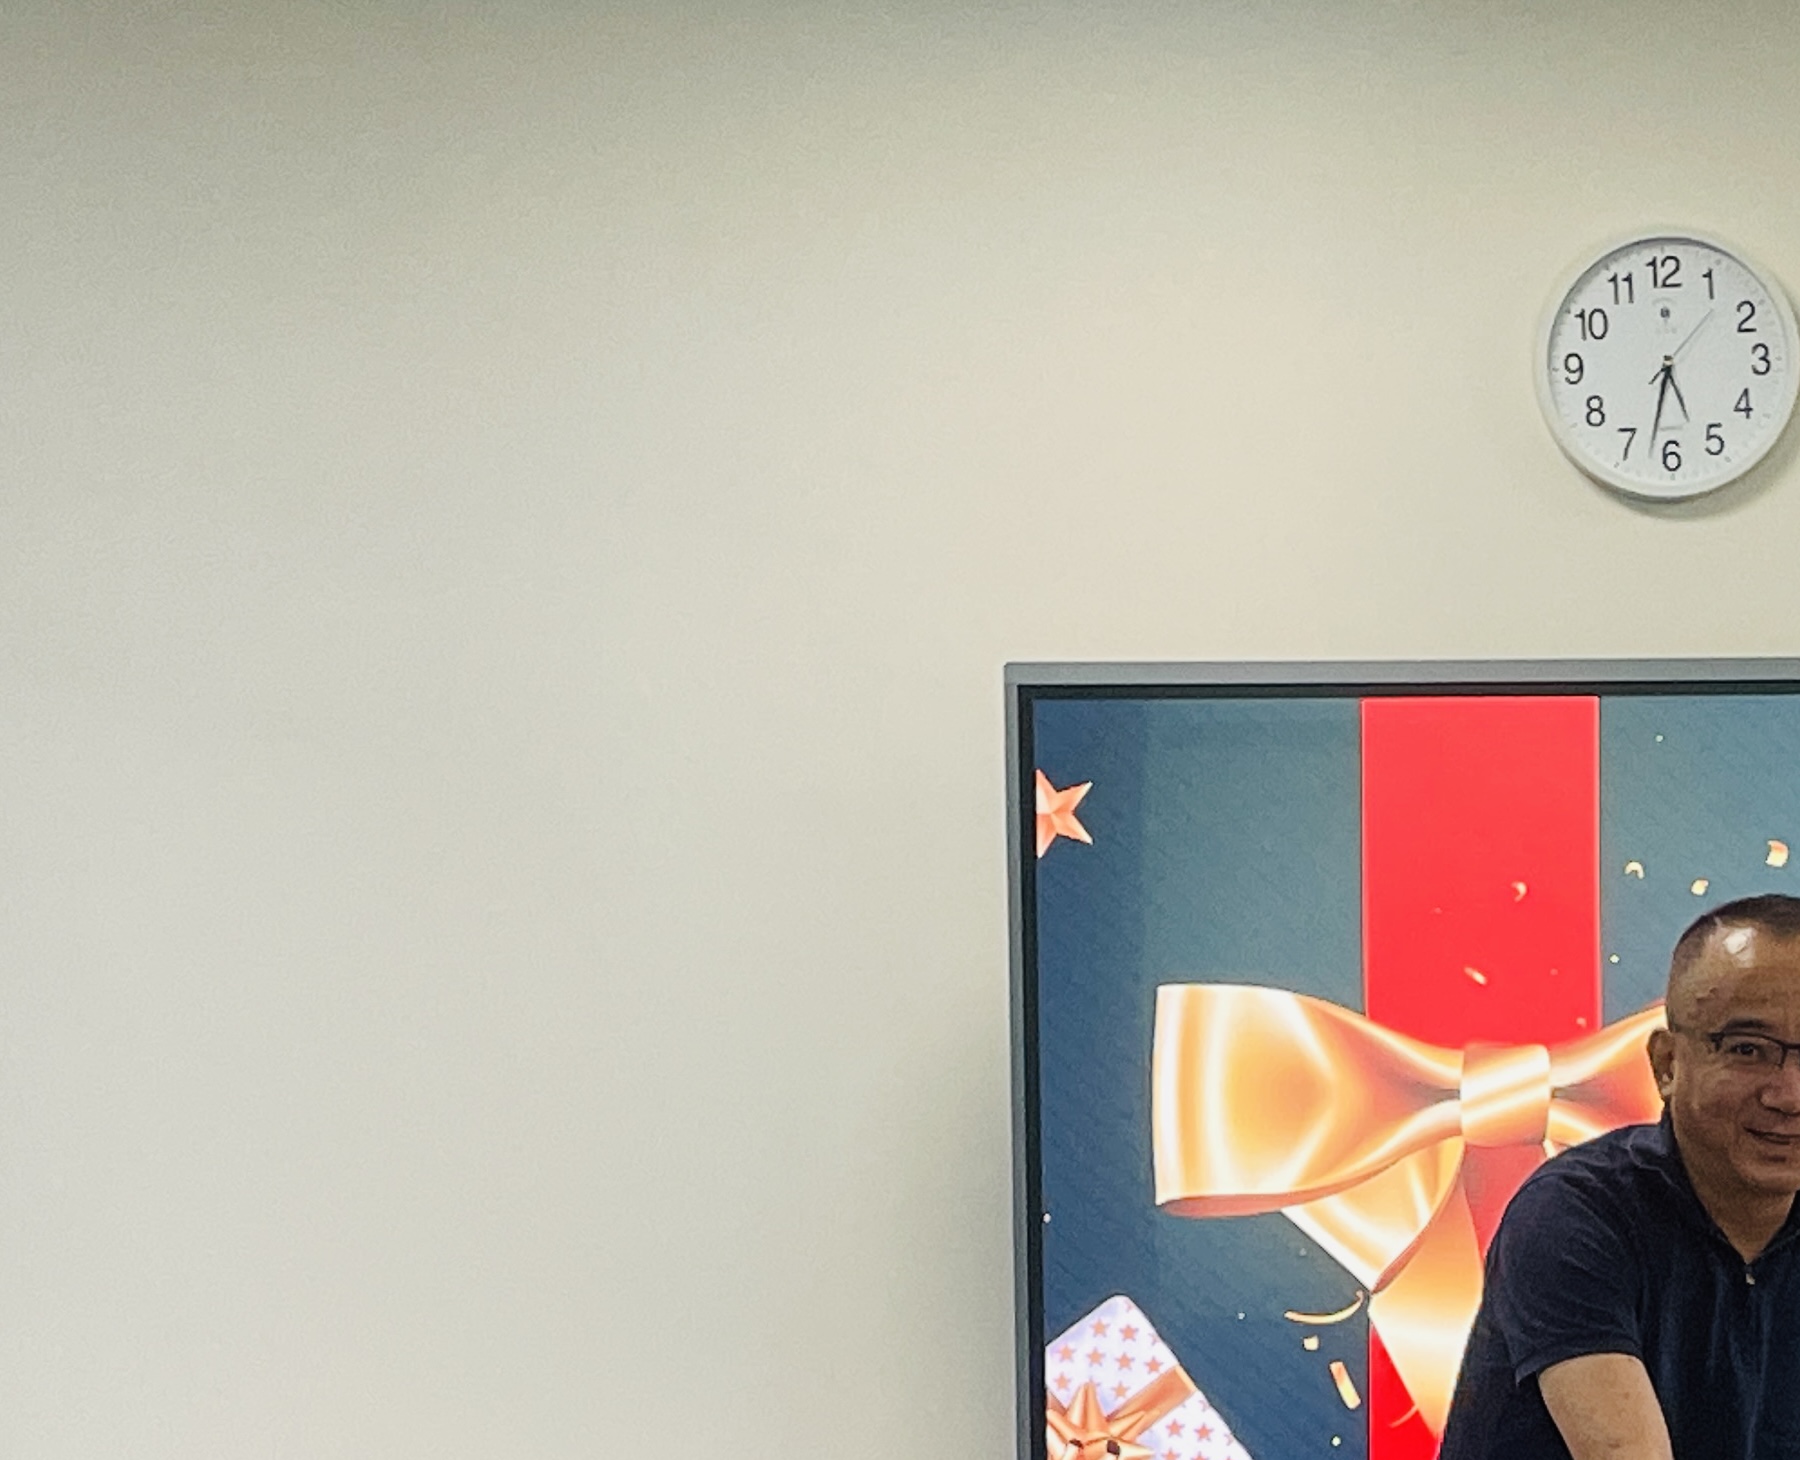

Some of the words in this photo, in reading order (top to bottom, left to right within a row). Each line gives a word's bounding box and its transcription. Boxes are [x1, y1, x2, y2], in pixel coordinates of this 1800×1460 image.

[1646, 255, 1682, 288] 12
[1702, 268, 1714, 300] 1
[1607, 272, 1634, 304] 11
[1574, 308, 1608, 340] 10
[1736, 300, 1757, 332] 2
[1564, 353, 1584, 384] 9
[1751, 343, 1771, 375] 3
[1585, 395, 1605, 426] 8
[1733, 388, 1753, 419] 4
[1618, 427, 1637, 461] 7
[1705, 422, 1725, 455] 5
[1661, 440, 1682, 471] 6
